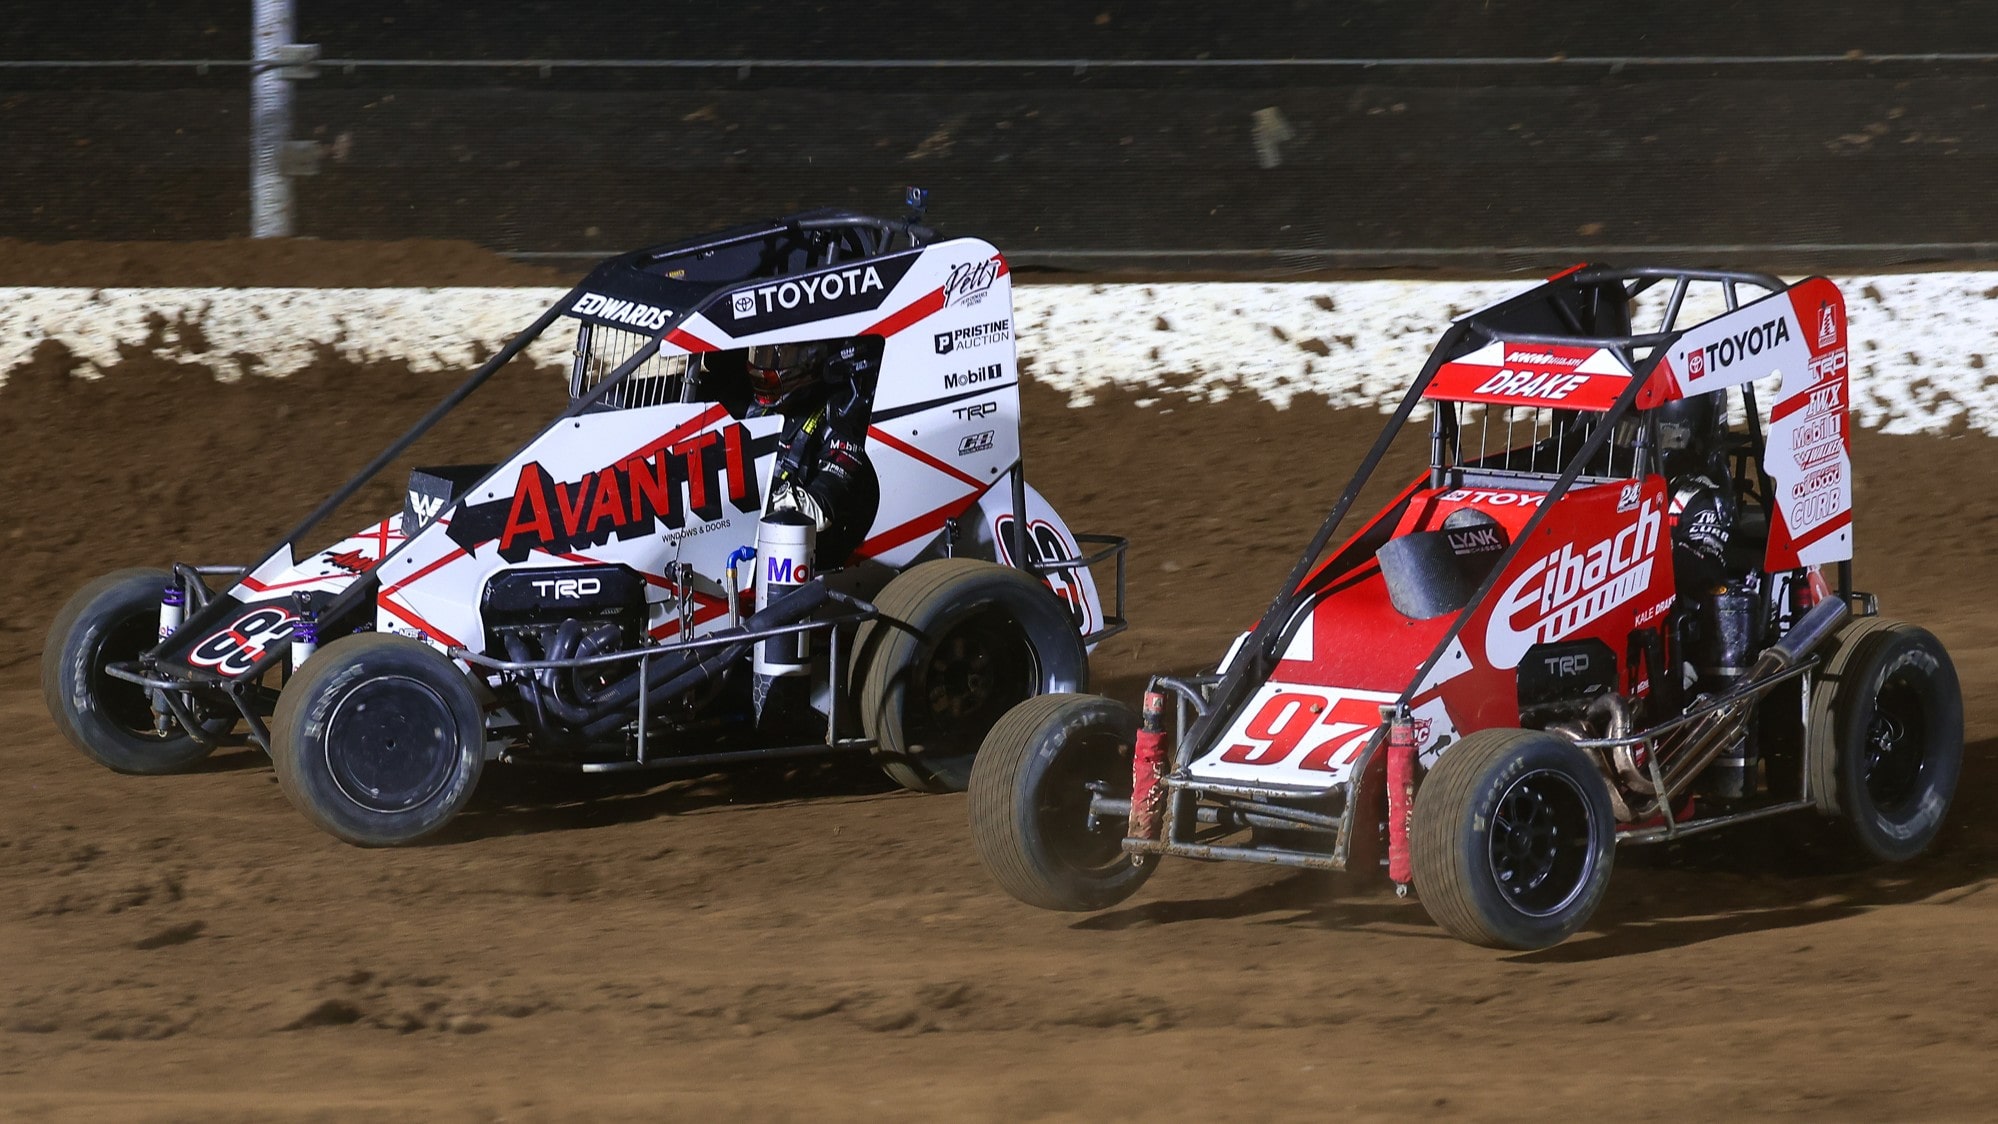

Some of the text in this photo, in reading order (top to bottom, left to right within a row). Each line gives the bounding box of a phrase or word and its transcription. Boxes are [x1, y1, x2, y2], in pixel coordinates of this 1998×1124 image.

[758, 266, 884, 313] TOYOTA
[571, 292, 673, 330] EDWARDS
[954, 319, 1009, 341] PRISTINE
[956, 331, 1009, 351] AUCTION
[1505, 351, 1553, 365] KKM
[1706, 316, 1790, 373] TOYOTA
[944, 363, 1002, 390] Mobil 1
[1808, 351, 1846, 380] TRD
[1474, 369, 1590, 400] DRAKE
[952, 402, 997, 421] TRD
[1793, 417, 1828, 450] Mobil
[499, 421, 752, 555] AVANTI
[1471, 490, 1546, 507] TOY
[1621, 482, 1641, 507] 24
[1791, 487, 1841, 530] CURB
[662, 519, 731, 543] WINDOWS & DOORS
[1447, 528, 1499, 550] LYNK
[768, 556, 815, 584] Mo
[532, 578, 601, 600] TRD
[1485, 498, 1661, 670] Eibach
[1635, 607, 1654, 627] KALE
[1545, 653, 1589, 677] TRD
[1219, 692, 1386, 773] 97
